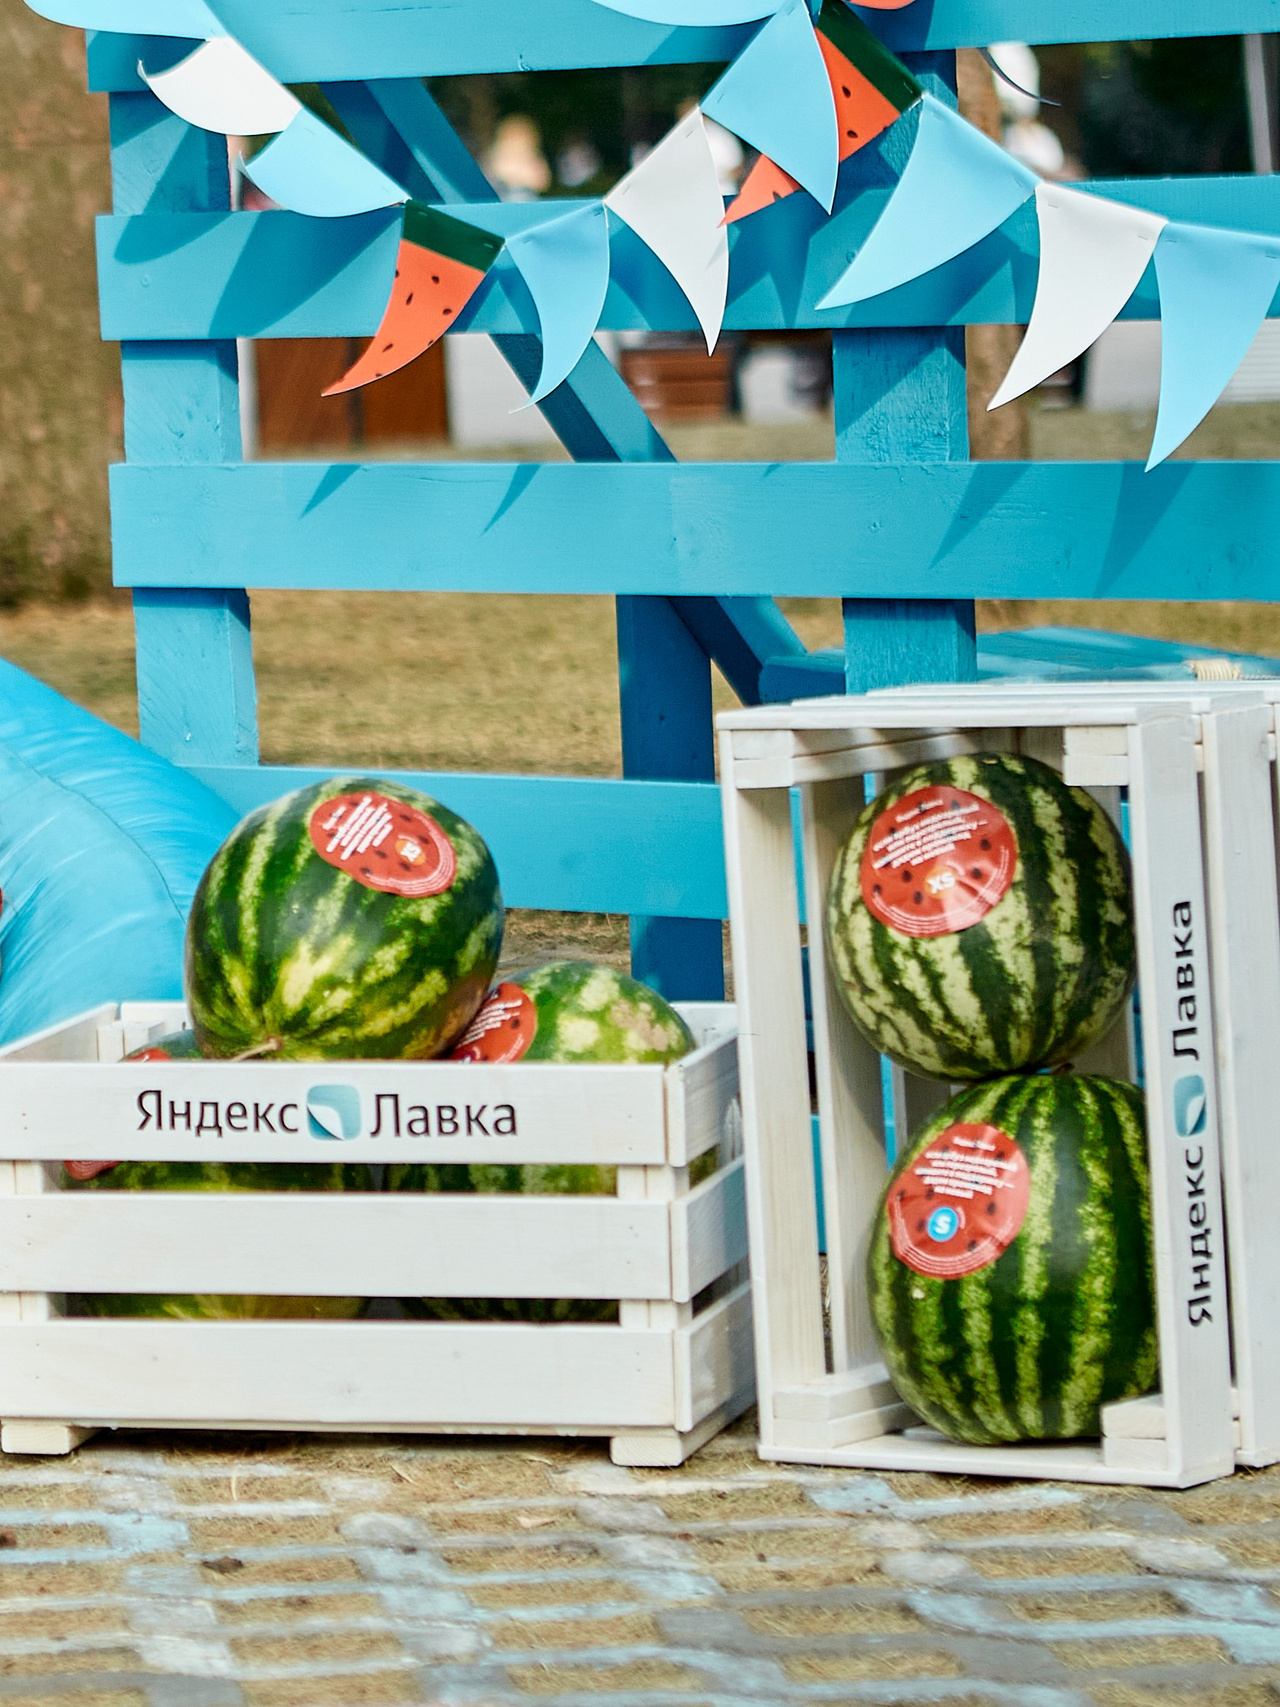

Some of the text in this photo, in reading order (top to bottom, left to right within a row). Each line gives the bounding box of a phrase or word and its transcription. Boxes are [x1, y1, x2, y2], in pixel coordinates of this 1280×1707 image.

[927, 872, 956, 894] XS
[135, 1089, 518, 1139] Яндекс Лавка
[1172, 900, 1213, 1328] Яндекс Лавка
[933, 1215, 951, 1235] S
